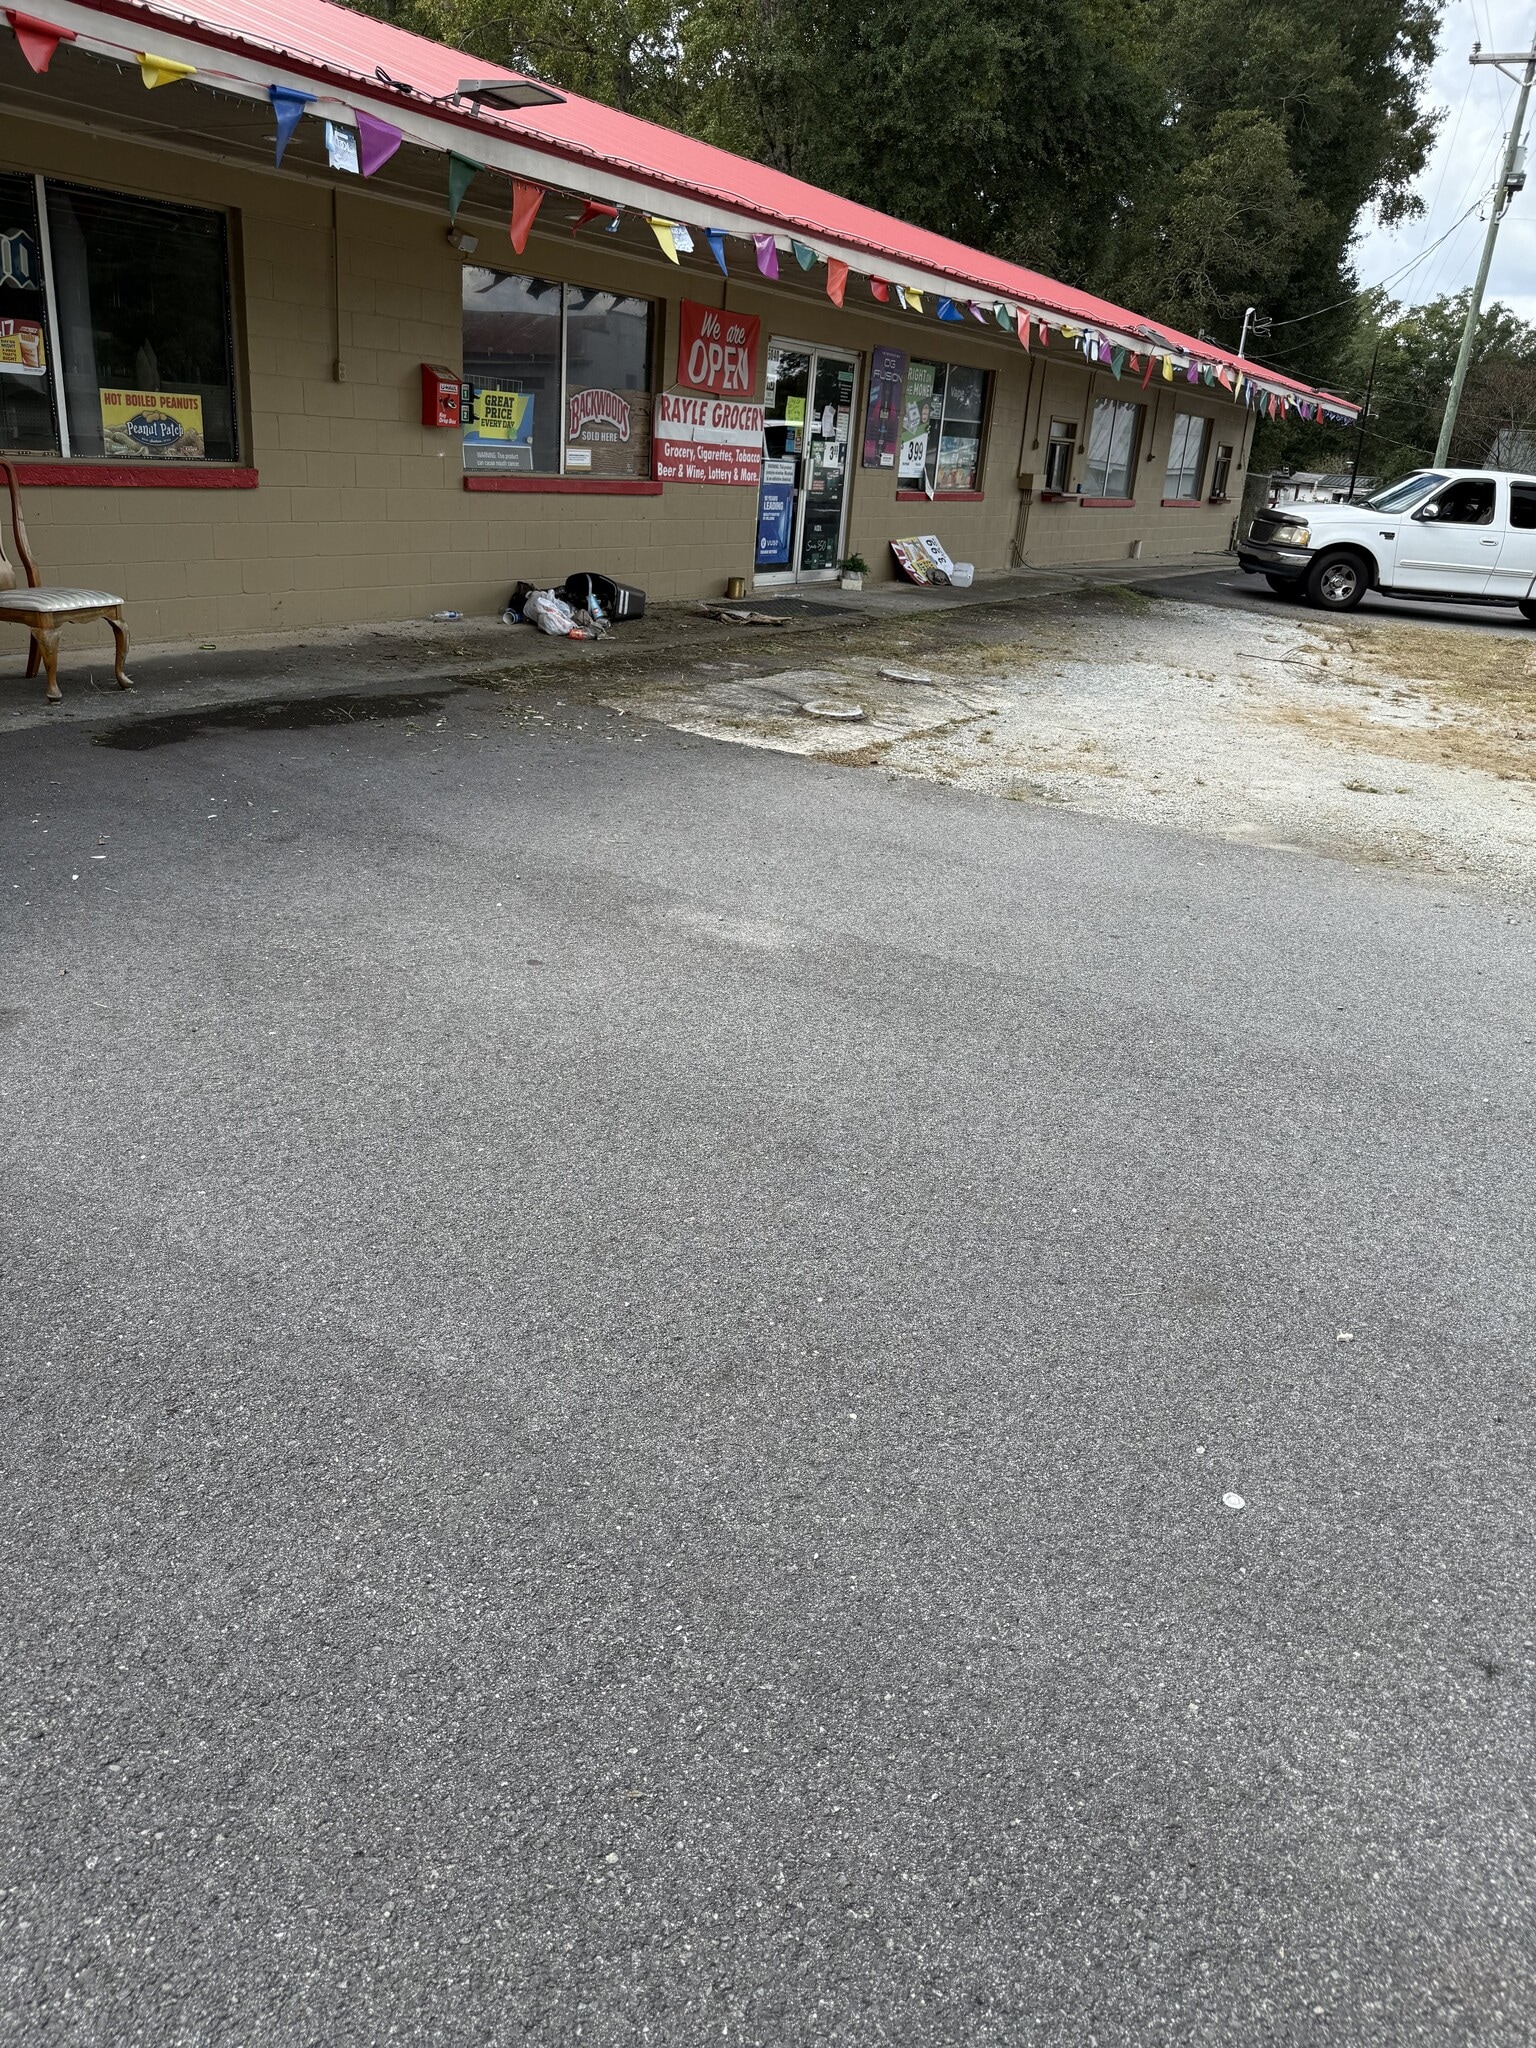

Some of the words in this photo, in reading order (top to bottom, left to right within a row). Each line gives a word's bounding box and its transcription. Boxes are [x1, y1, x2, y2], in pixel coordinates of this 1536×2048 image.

[701, 311, 721, 341] We
[727, 324, 746, 345] are
[688, 339, 749, 390] OPEN
[908, 367, 926, 381] RIGHT
[913, 384, 933, 397] MONEY
[104, 392, 122, 406] HOT
[125, 394, 157, 408] BOILED
[160, 396, 199, 410] PEANUTS
[485, 394, 515, 409] GREAT
[485, 406, 512, 420] PRICE
[570, 389, 630, 441] BACKWOODS
[661, 395, 708, 426] RAYLE
[712, 402, 764, 432] GROCERY
[127, 421, 158, 437] Peanut
[160, 422, 184, 437] Patch
[480, 419, 502, 429] EVERY
[503, 420, 516, 429] DAY
[582, 430, 600, 441] SOLD
[601, 432, 618, 442] HERE
[664, 442, 696, 463] Grocery,
[697, 445, 734, 464] Cigarettes,
[735, 448, 761, 464] Tobacco
[908, 441, 923, 462] 3.99
[657, 462, 677, 478] Beer
[678, 465, 684, 478] &
[686, 464, 706, 480] Wine,
[708, 467, 732, 483] Lottery
[733, 469, 739, 481] &
[763, 501, 784, 511] LEADING
